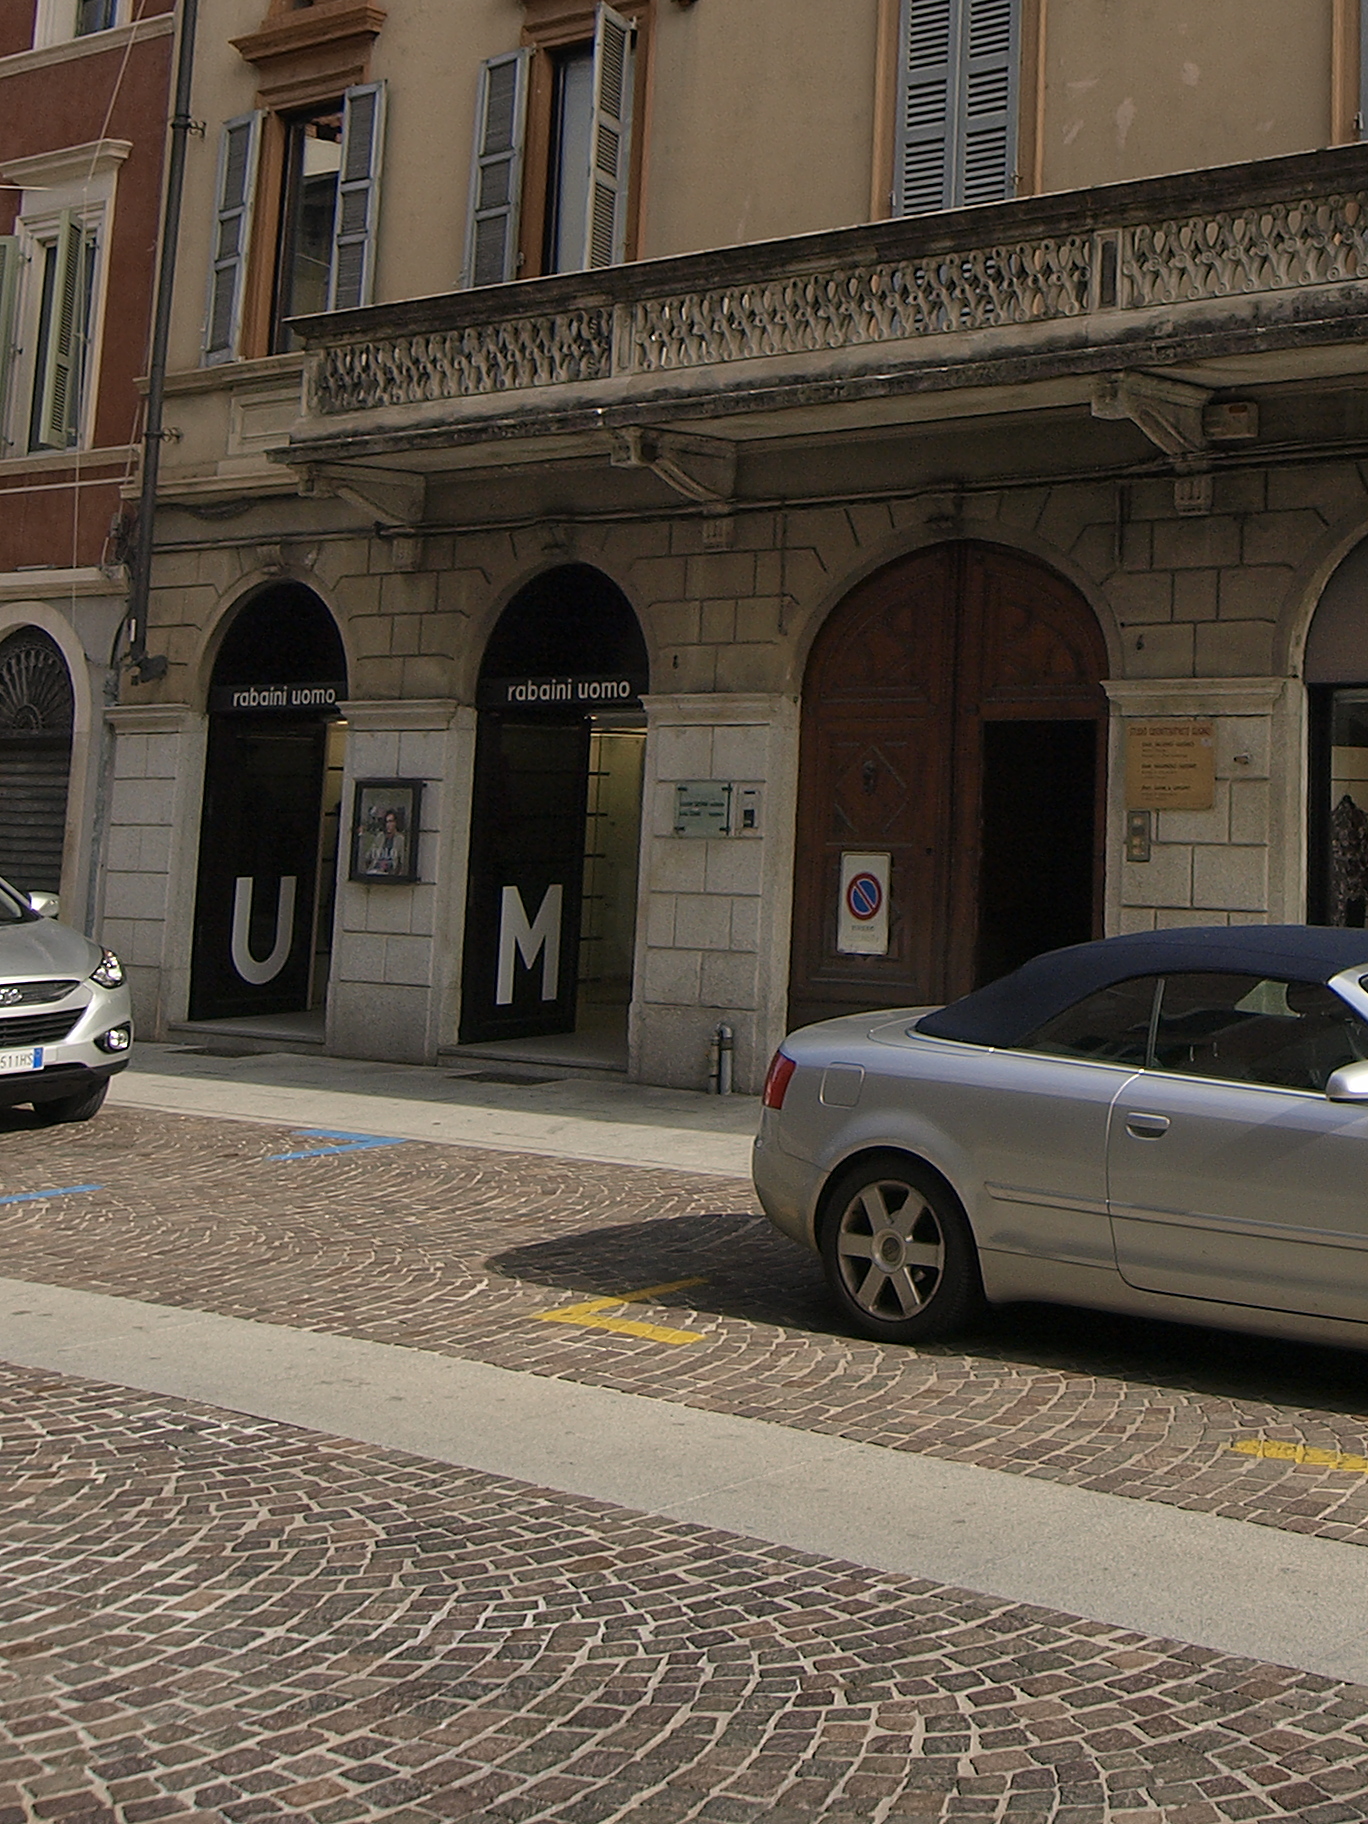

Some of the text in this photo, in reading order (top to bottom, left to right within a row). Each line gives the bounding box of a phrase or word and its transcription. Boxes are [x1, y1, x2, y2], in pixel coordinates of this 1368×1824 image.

[233, 685, 336, 707] rabaini uomo
[507, 678, 630, 701] rabaini uomo
[231, 876, 297, 985] U
[496, 884, 563, 1005] M
